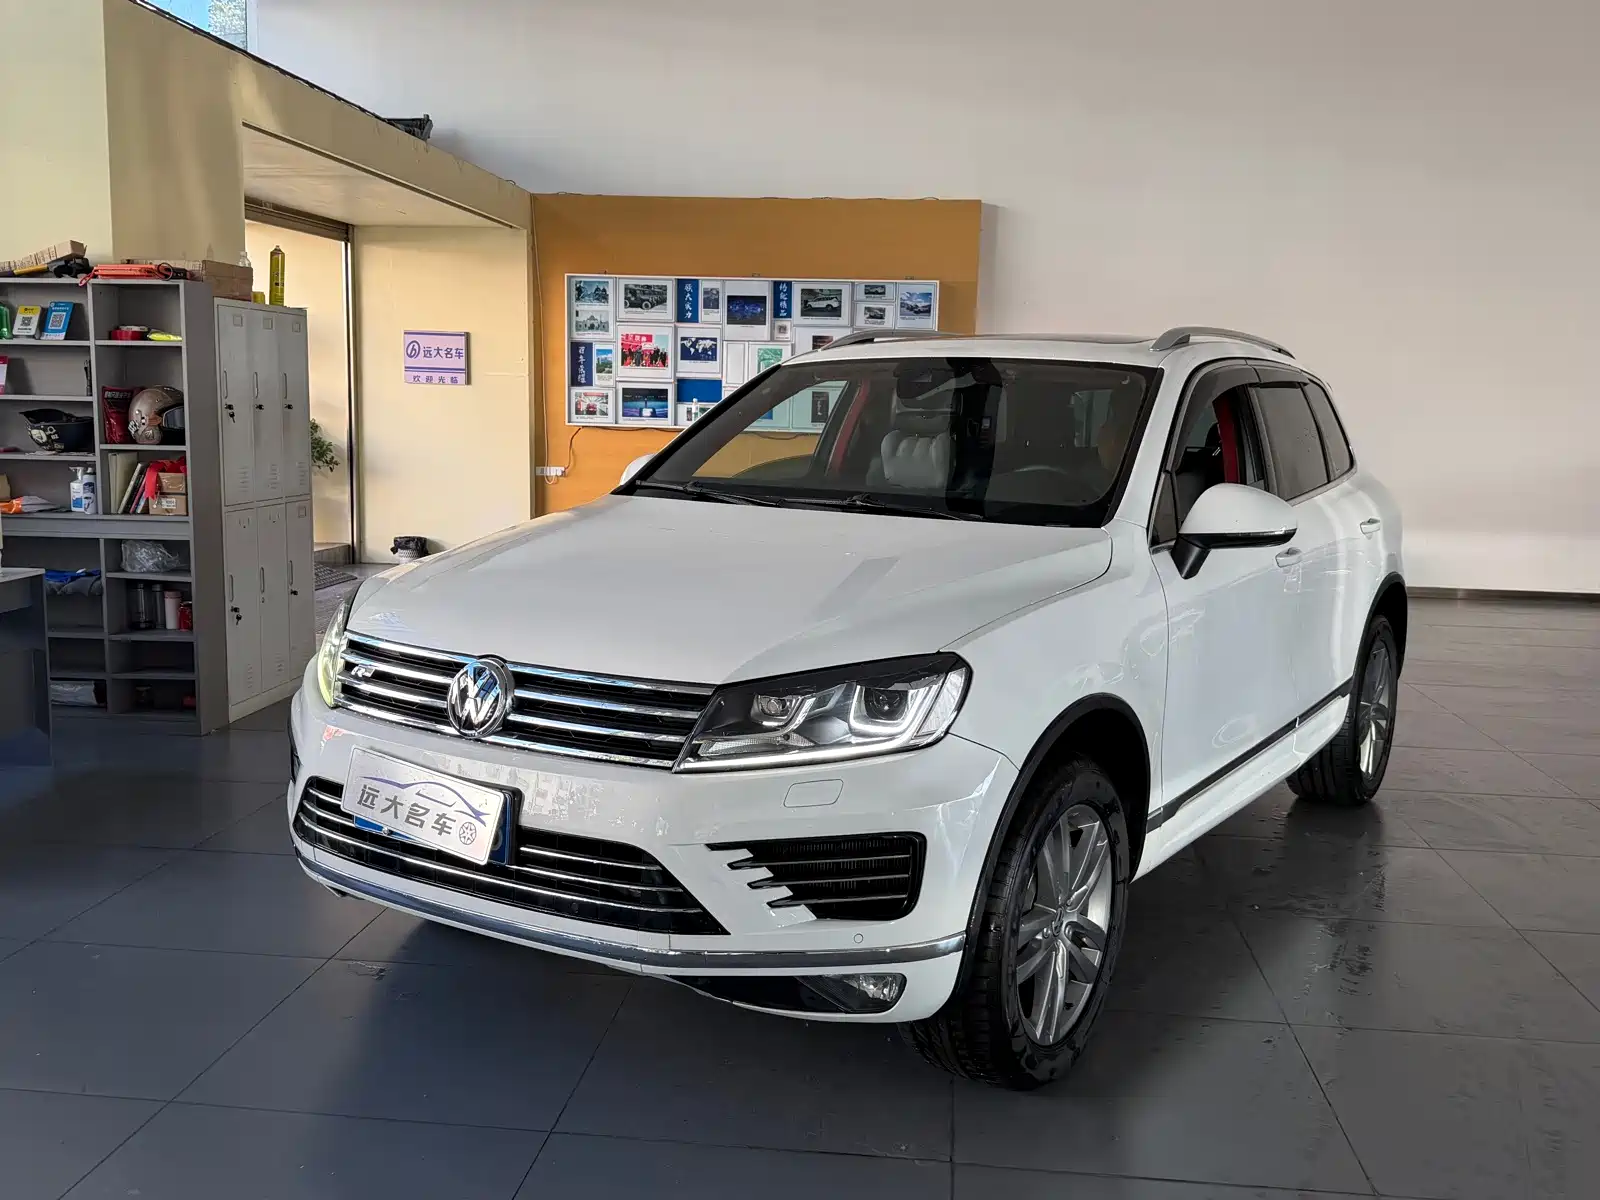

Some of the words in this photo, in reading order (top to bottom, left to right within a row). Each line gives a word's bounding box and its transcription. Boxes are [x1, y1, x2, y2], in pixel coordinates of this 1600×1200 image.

[423, 346, 464, 360] 远大名车
[413, 375, 459, 384] 欢迎光临
[357, 784, 457, 837] 远大名车
